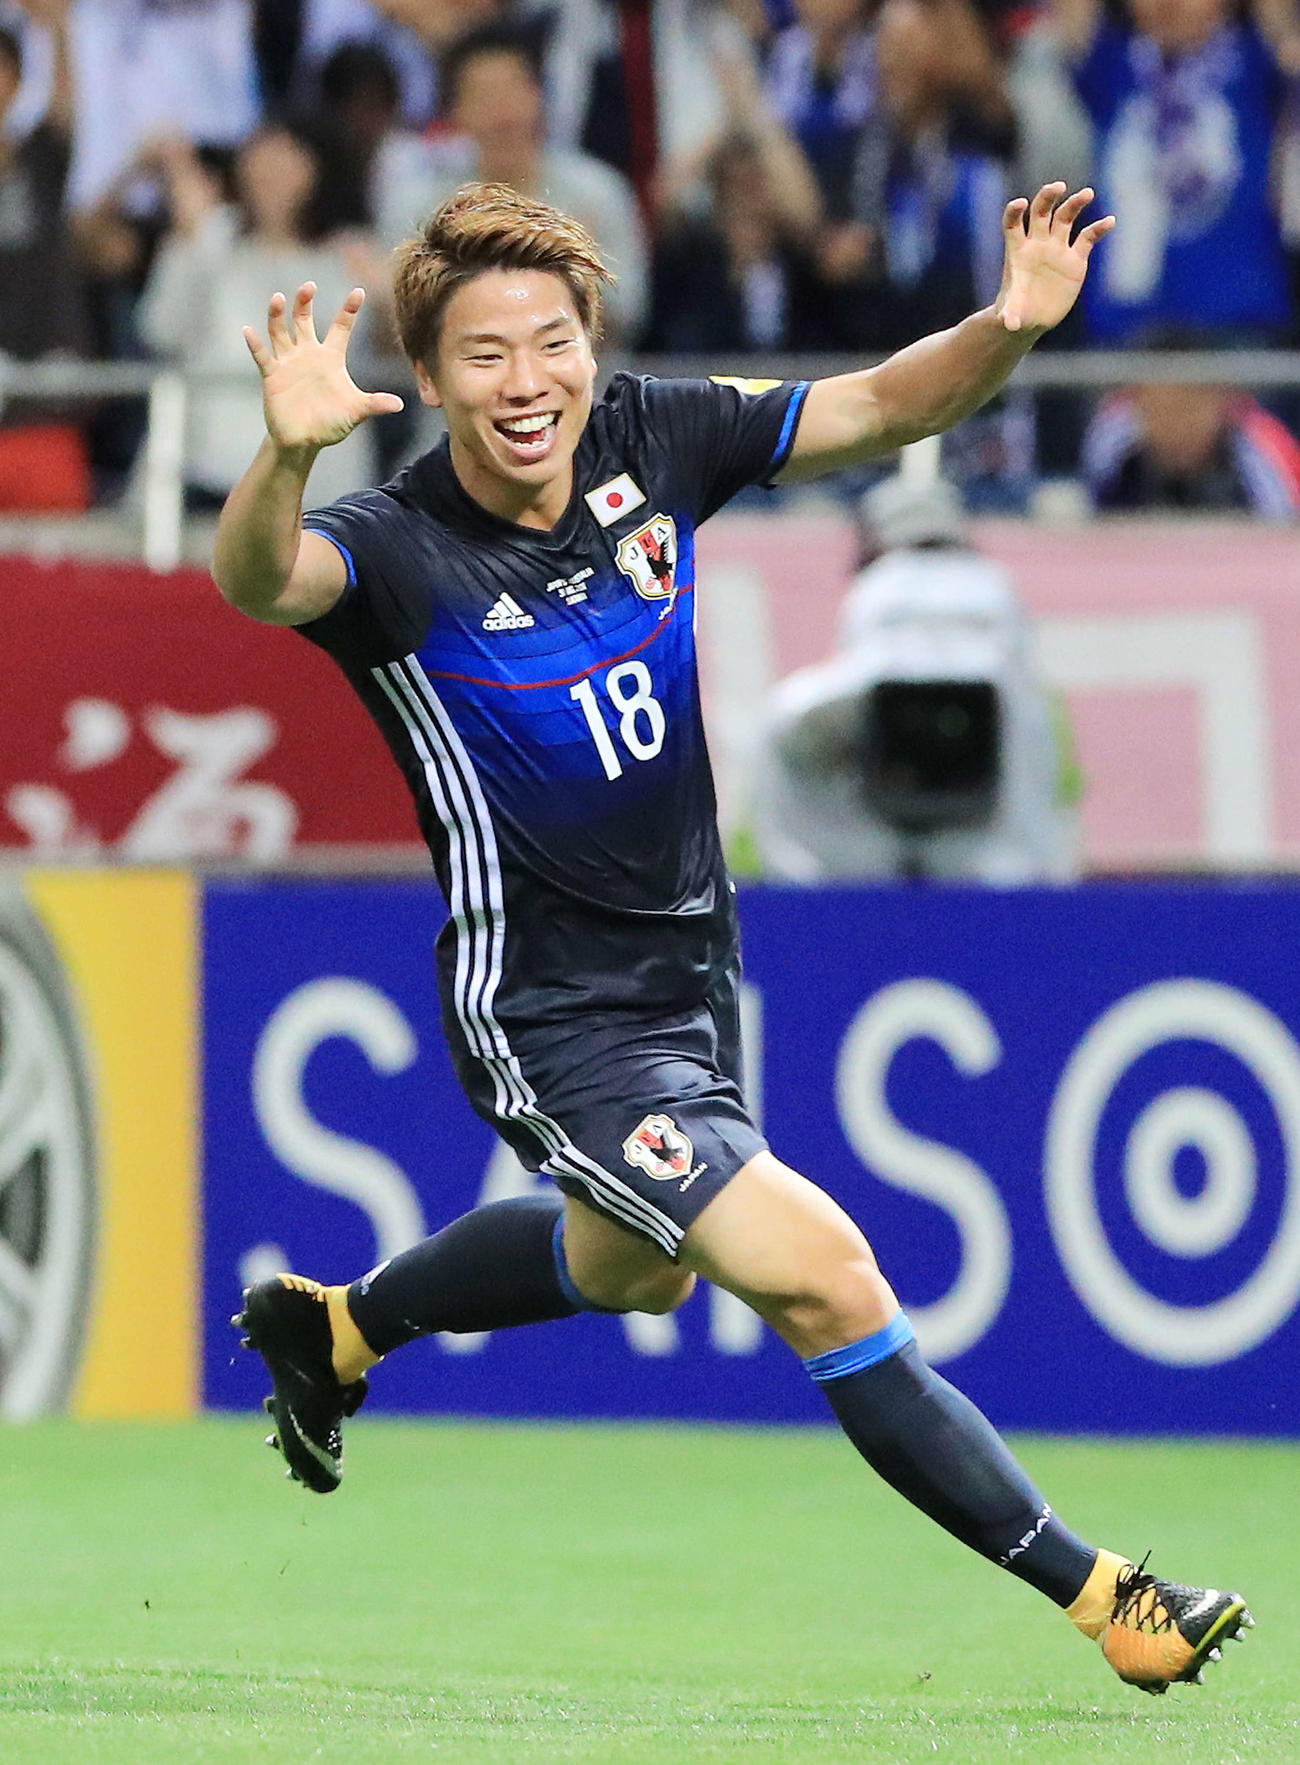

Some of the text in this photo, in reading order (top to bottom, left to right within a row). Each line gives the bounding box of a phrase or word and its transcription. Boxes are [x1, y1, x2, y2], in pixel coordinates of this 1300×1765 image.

[482, 614, 535, 631] adidas
[569, 660, 667, 781] 18
[239, 975, 1300, 1367] SSO
[679, 1162, 708, 1192] JAPAN
[1000, 1502, 1052, 1566] JAPAN
